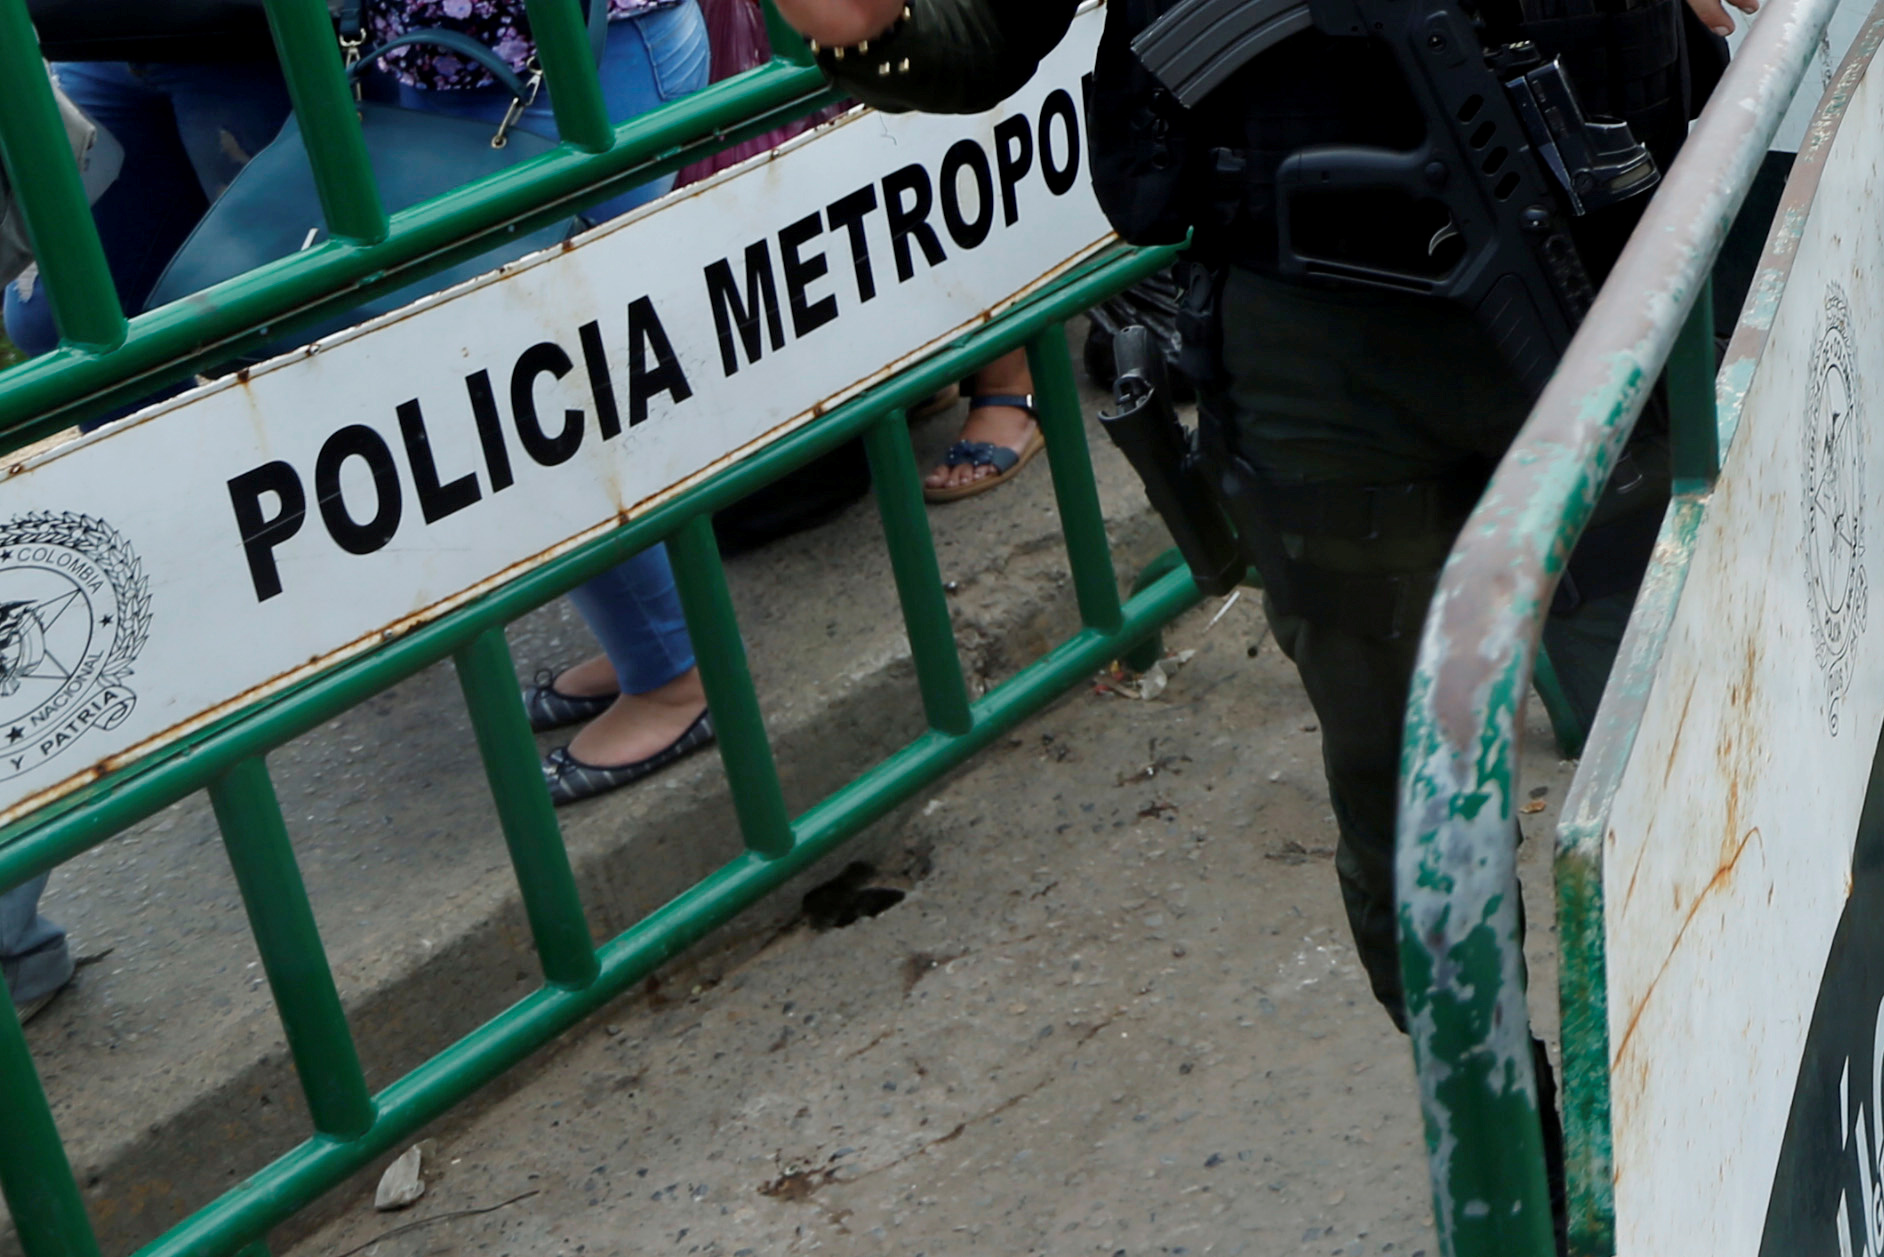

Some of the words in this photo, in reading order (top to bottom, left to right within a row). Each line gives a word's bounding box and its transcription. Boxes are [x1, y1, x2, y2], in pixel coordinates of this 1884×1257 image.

[228, 295, 692, 603] POLICIA
[17, 547, 104, 595] COLOMBIA
[30, 649, 105, 727] NACIONAL
[10, 754, 24, 772] Y
[40, 688, 119, 756] PATRIA
